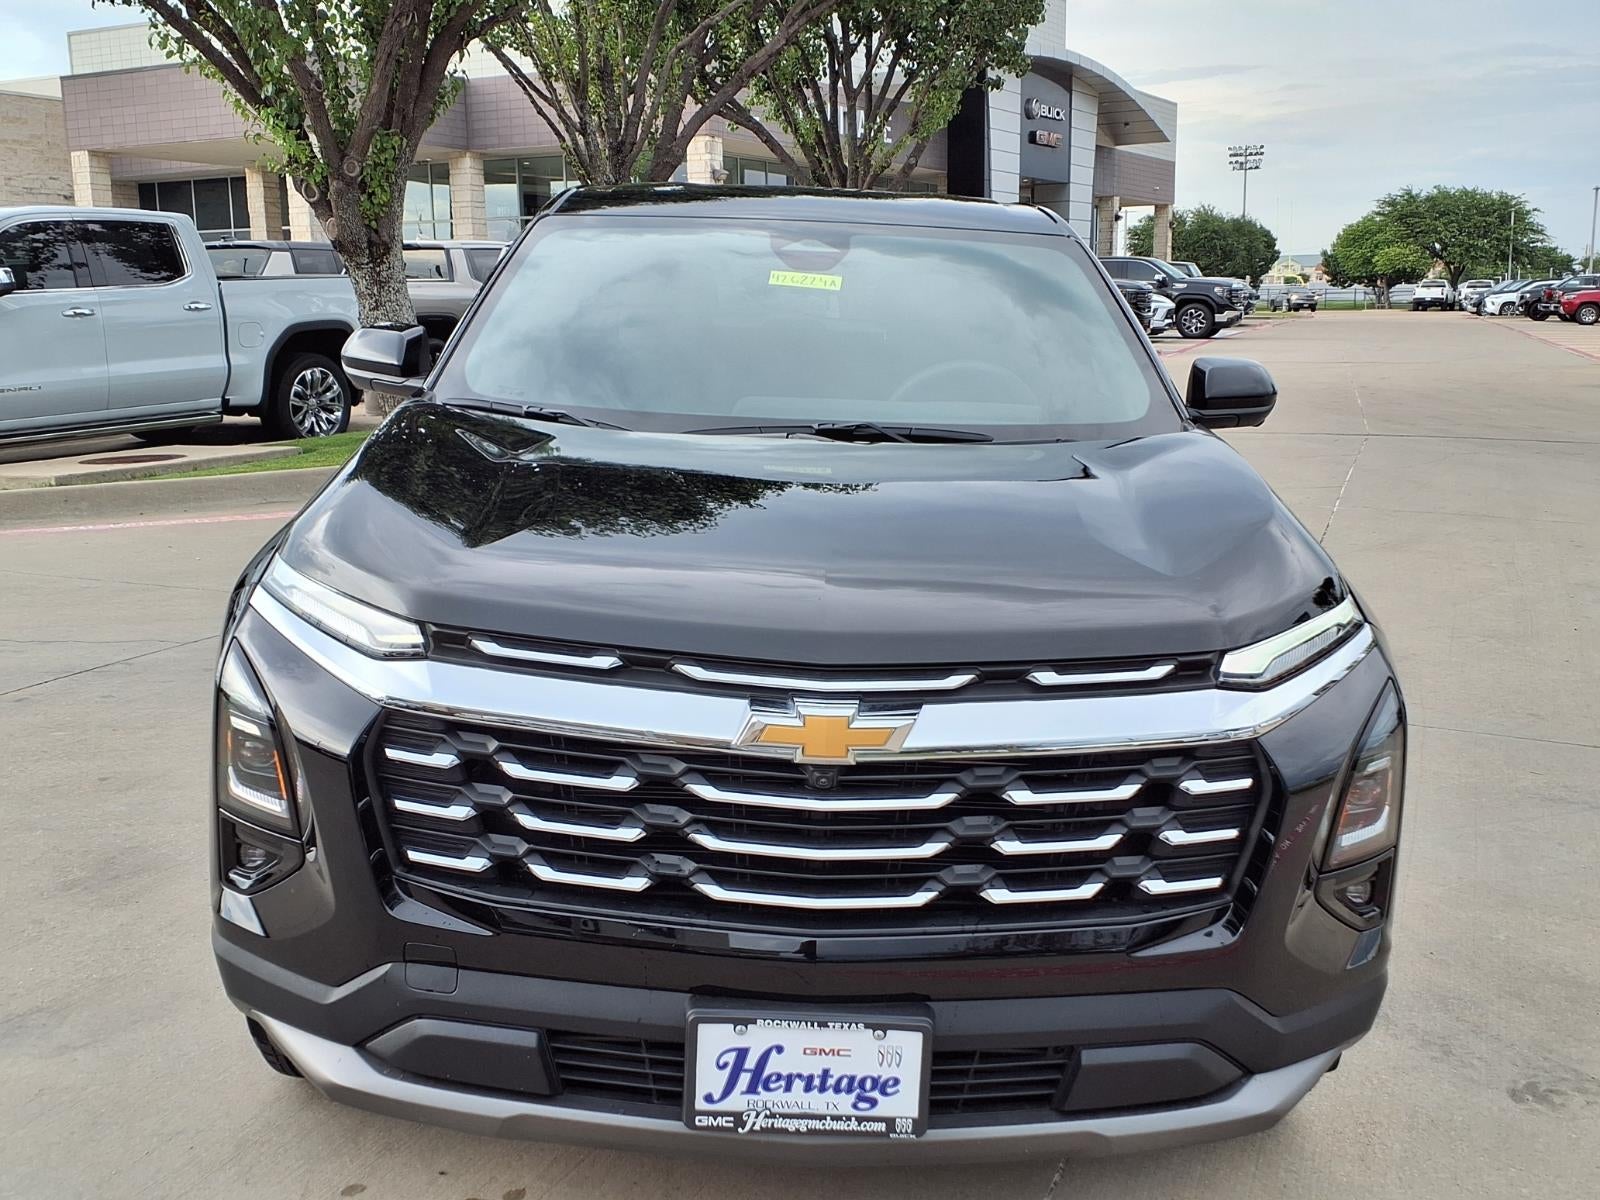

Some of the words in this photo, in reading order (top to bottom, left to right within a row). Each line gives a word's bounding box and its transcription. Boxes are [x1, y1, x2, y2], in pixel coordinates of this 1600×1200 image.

[1040, 104, 1065, 120] BUICK
[1036, 130, 1064, 147] GMC
[756, 1019, 824, 1031] ROCKWALL,
[827, 1021, 865, 1032] TEXAS
[803, 1047, 852, 1057] GMC
[702, 1044, 901, 1112] Heritage
[746, 1099, 820, 1112] ROCKWALL,
[824, 1101, 840, 1112] TX
[694, 1115, 734, 1127] GMC
[738, 1110, 887, 1134] Heritagegmcbuick.com
